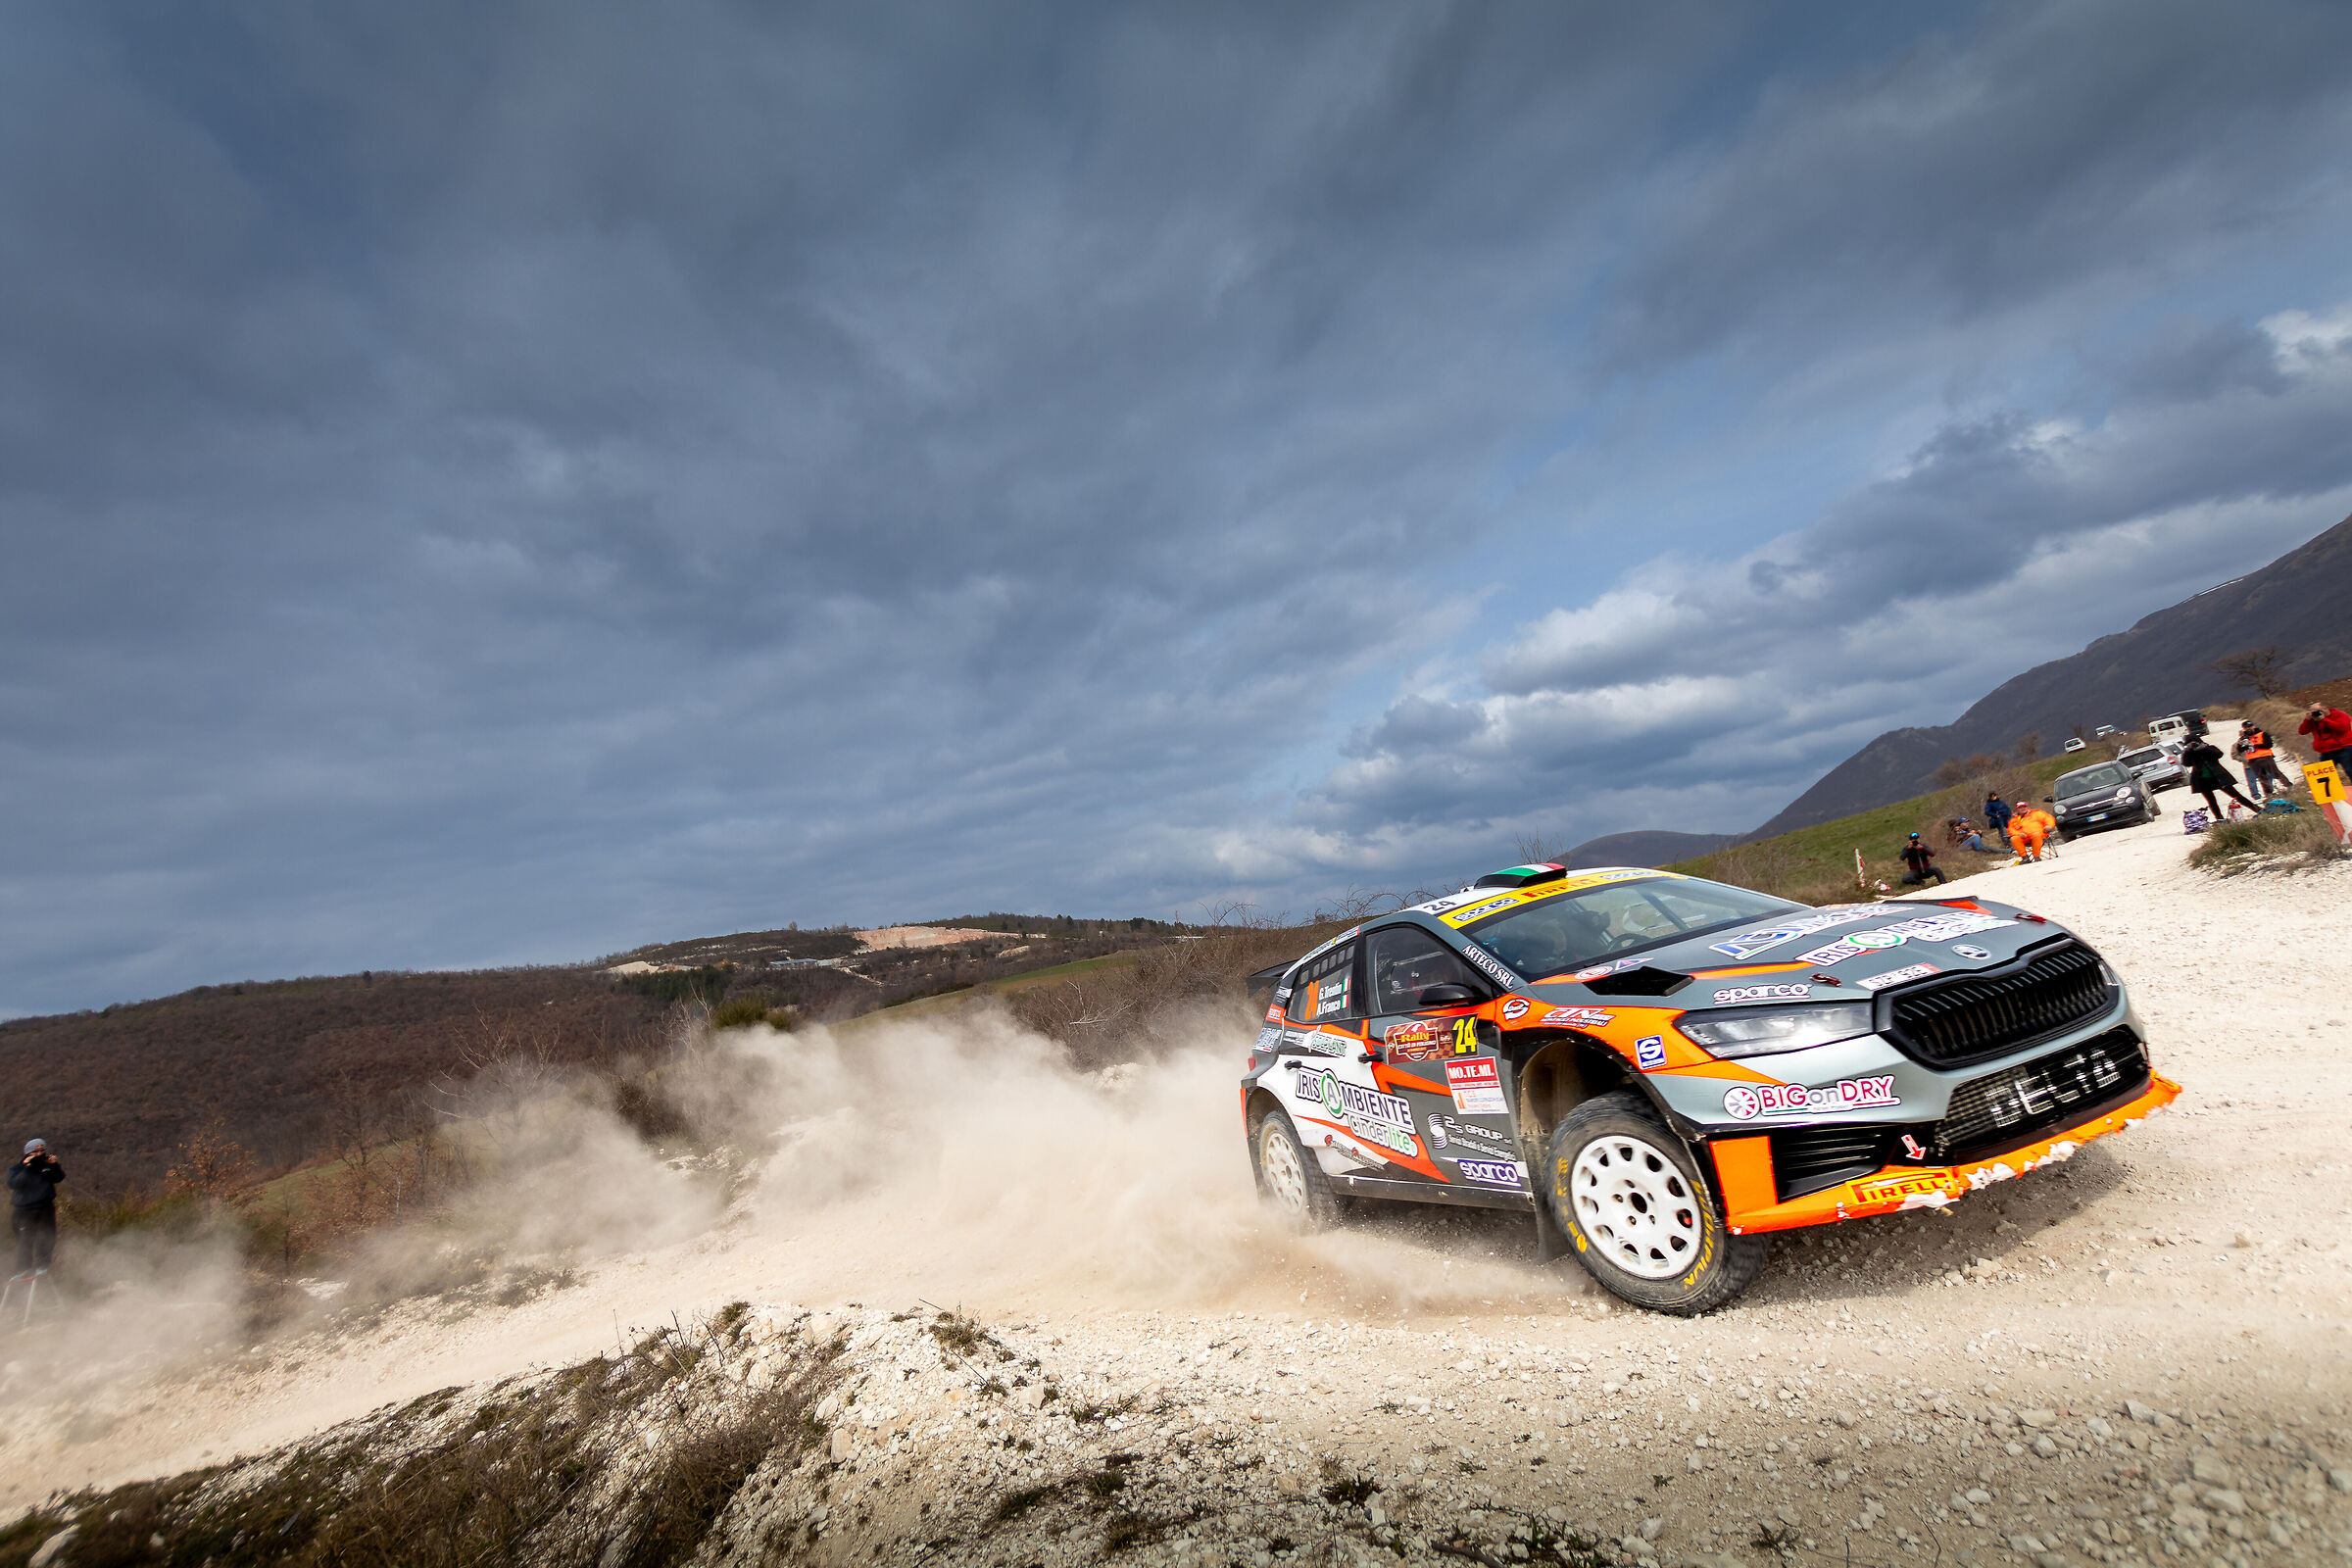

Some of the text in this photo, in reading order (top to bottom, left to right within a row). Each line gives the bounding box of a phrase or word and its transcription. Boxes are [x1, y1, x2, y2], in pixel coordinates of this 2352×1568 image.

[2306, 766, 2335, 776] PLACE
[2317, 777, 2331, 797] 7
[1423, 898, 1457, 911] 24
[1453, 898, 1517, 921] sparco
[1462, 944, 1515, 989] ARTECO SRL
[1713, 984, 1810, 1004] sparco
[1400, 1032, 1430, 1043] Rally
[1452, 1016, 1477, 1054] 24
[1761, 1078, 1889, 1108] BIGonDRY
[1984, 1049, 2122, 1128] DELTA
[1465, 1124, 1503, 1141] GROUP
[1459, 1162, 1518, 1182] sparco
